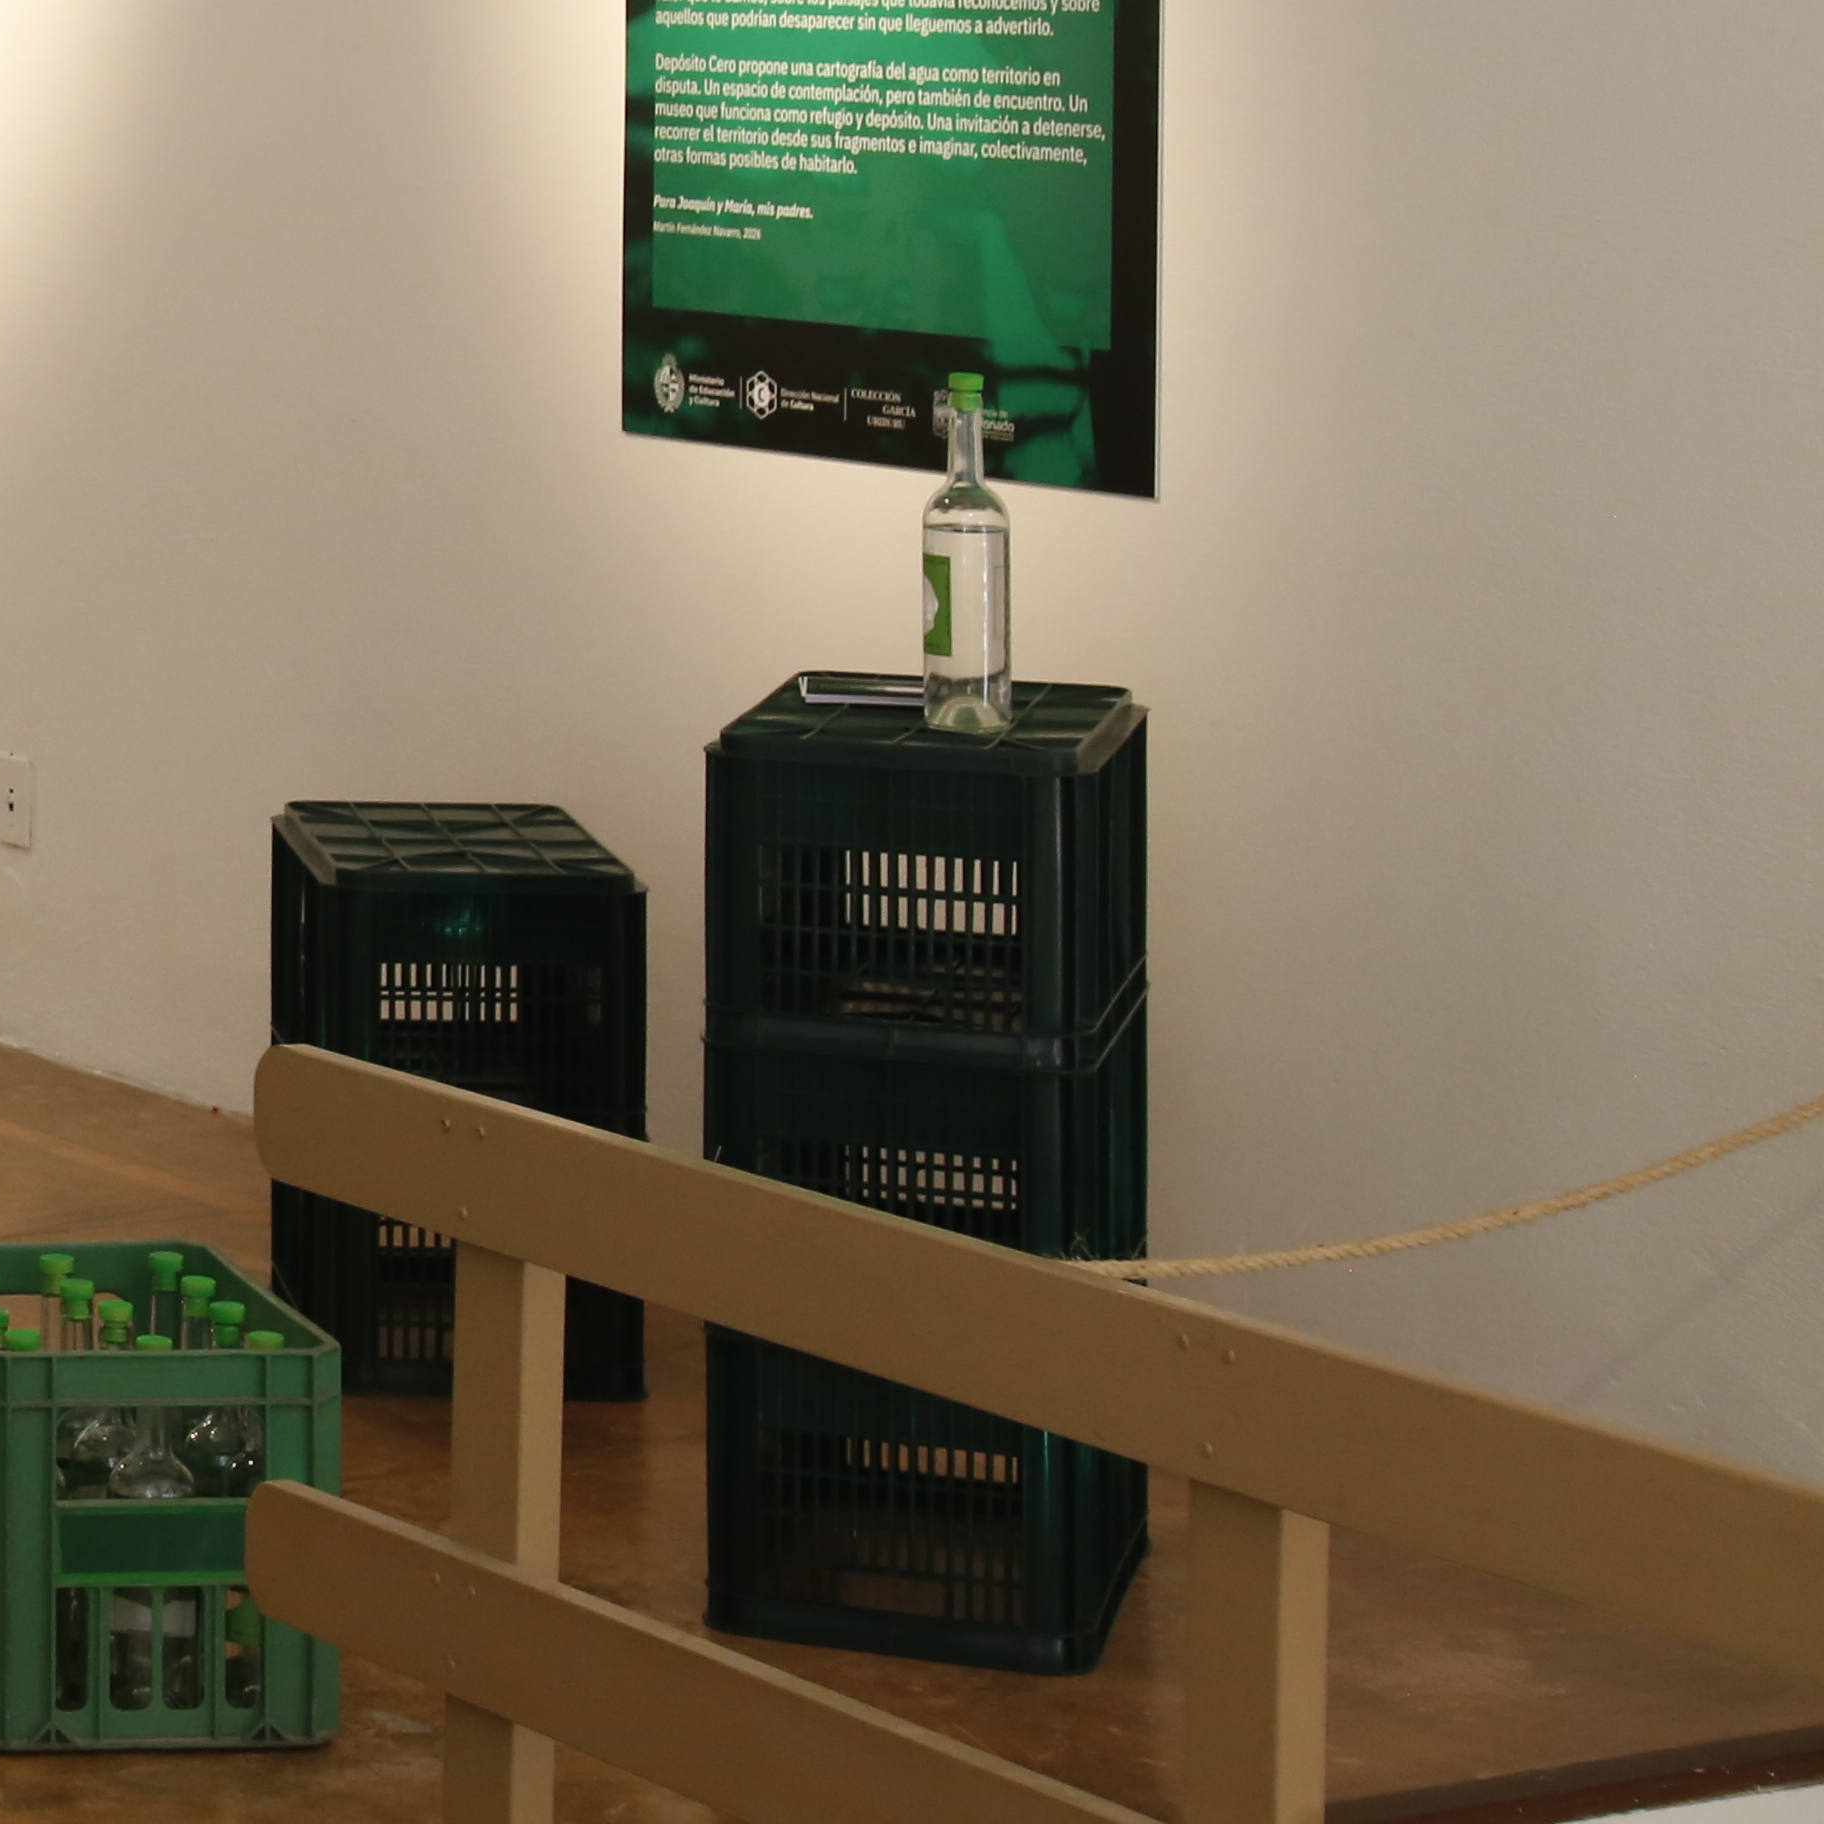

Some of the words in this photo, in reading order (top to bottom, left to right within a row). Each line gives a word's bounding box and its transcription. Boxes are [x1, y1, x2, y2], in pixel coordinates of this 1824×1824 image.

[656, 8, 705, 30] aquellos
[706, 13, 730, 31] que
[731, 10, 778, 32] podrían
[779, 11, 856, 34] desaparecer
[858, 13, 877, 32] sin
[878, 18, 904, 36] que
[905, 14, 973, 37] lleguemos
[974, 20, 984, 35] a
[986, 17, 1054, 37] advertirlo.
[656, 54, 708, 76] Depósito
[708, 56, 737, 75] Cero
[738, 61, 790, 80] propone
[791, 63, 815, 78] una
[816, 62, 884, 83] cartografía
[886, 62, 907, 81] del
[908, 67, 941, 86] agua
[942, 69, 980, 84] como
[982, 67, 1042, 86] territorio
[1043, 72, 1061, 87] en
[655, 78, 702, 101] disputa.
[704, 80, 721, 99] Un
[722, 82, 770, 103] espacio
[770, 83, 787, 101] de
[788, 85, 884, 108] contemplación,
[886, 91, 916, 109] pero
[918, 89, 972, 109] también
[973, 91, 992, 110] de
[993, 95, 1066, 113] encuentro.
[1069, 95, 1088, 114] Un
[654, 148, 684, 165] otras
[686, 147, 728, 168] formas
[729, 151, 780, 172] posibles
[781, 153, 798, 172] de
[799, 154, 858, 176] habitarlo.
[653, 193, 678, 210] Para
[677, 195, 717, 215] Joaquín
[716, 201, 724, 216] y
[757, 201, 777, 217] mis
[689, 373, 725, 387] Ministerio
[699, 385, 735, 398] Educación
[780, 387, 810, 399] Dirección
[811, 390, 840, 404] Nacional
[851, 388, 901, 403] COLECCIÓN
[694, 396, 720, 407] Cultura
[790, 400, 814, 412] Cultura
[882, 403, 916, 418] GARCÍA
